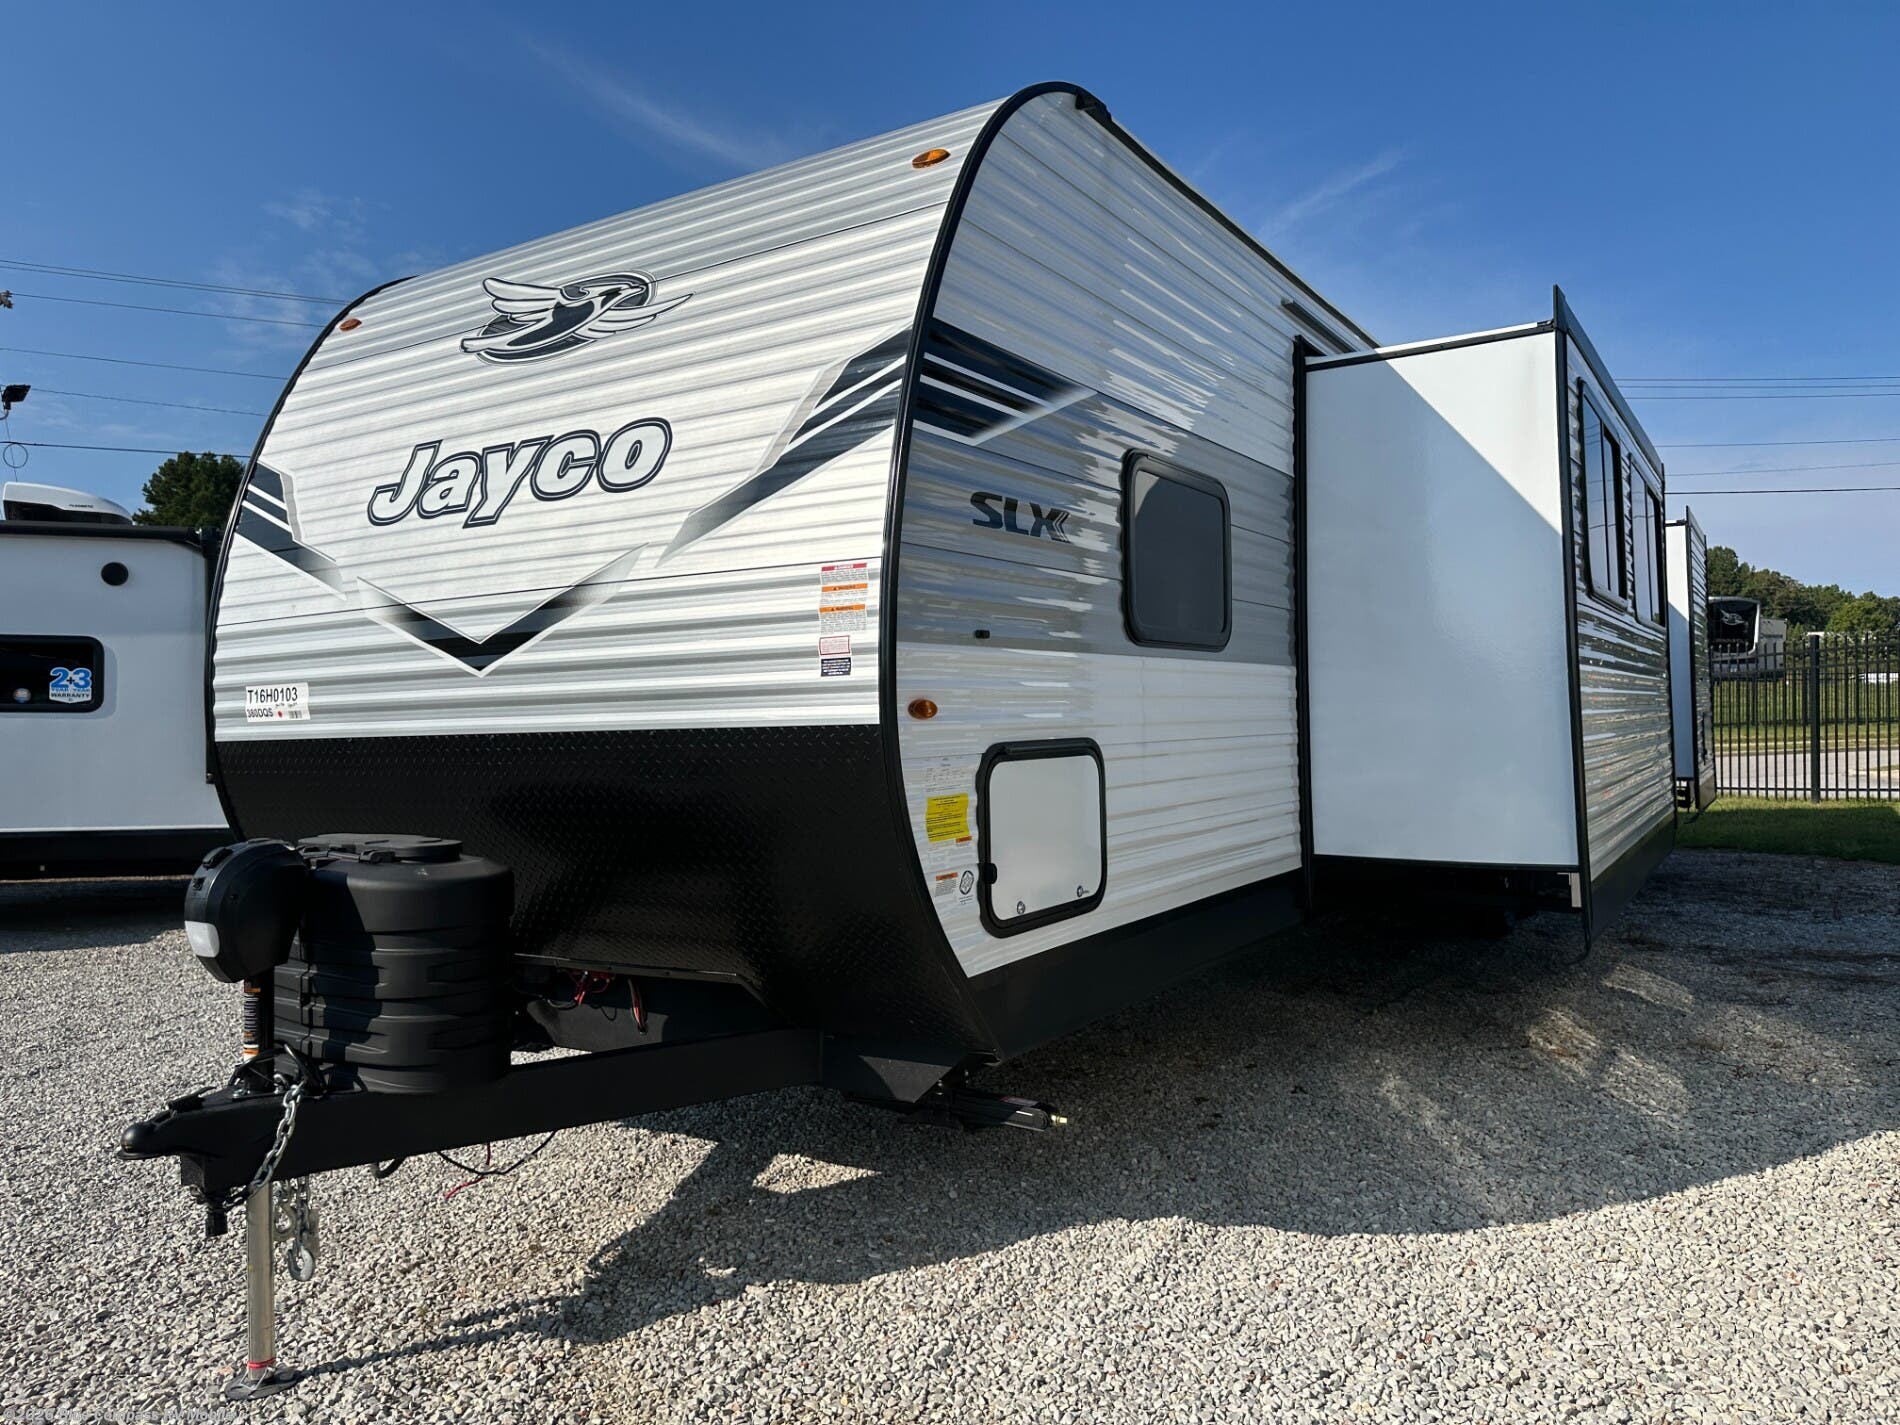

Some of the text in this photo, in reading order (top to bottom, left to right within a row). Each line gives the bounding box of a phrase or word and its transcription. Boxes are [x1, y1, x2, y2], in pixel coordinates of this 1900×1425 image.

[367, 417, 673, 529] Jayco
[970, 491, 1071, 543] SLX
[247, 687, 298, 704] T16H0103
